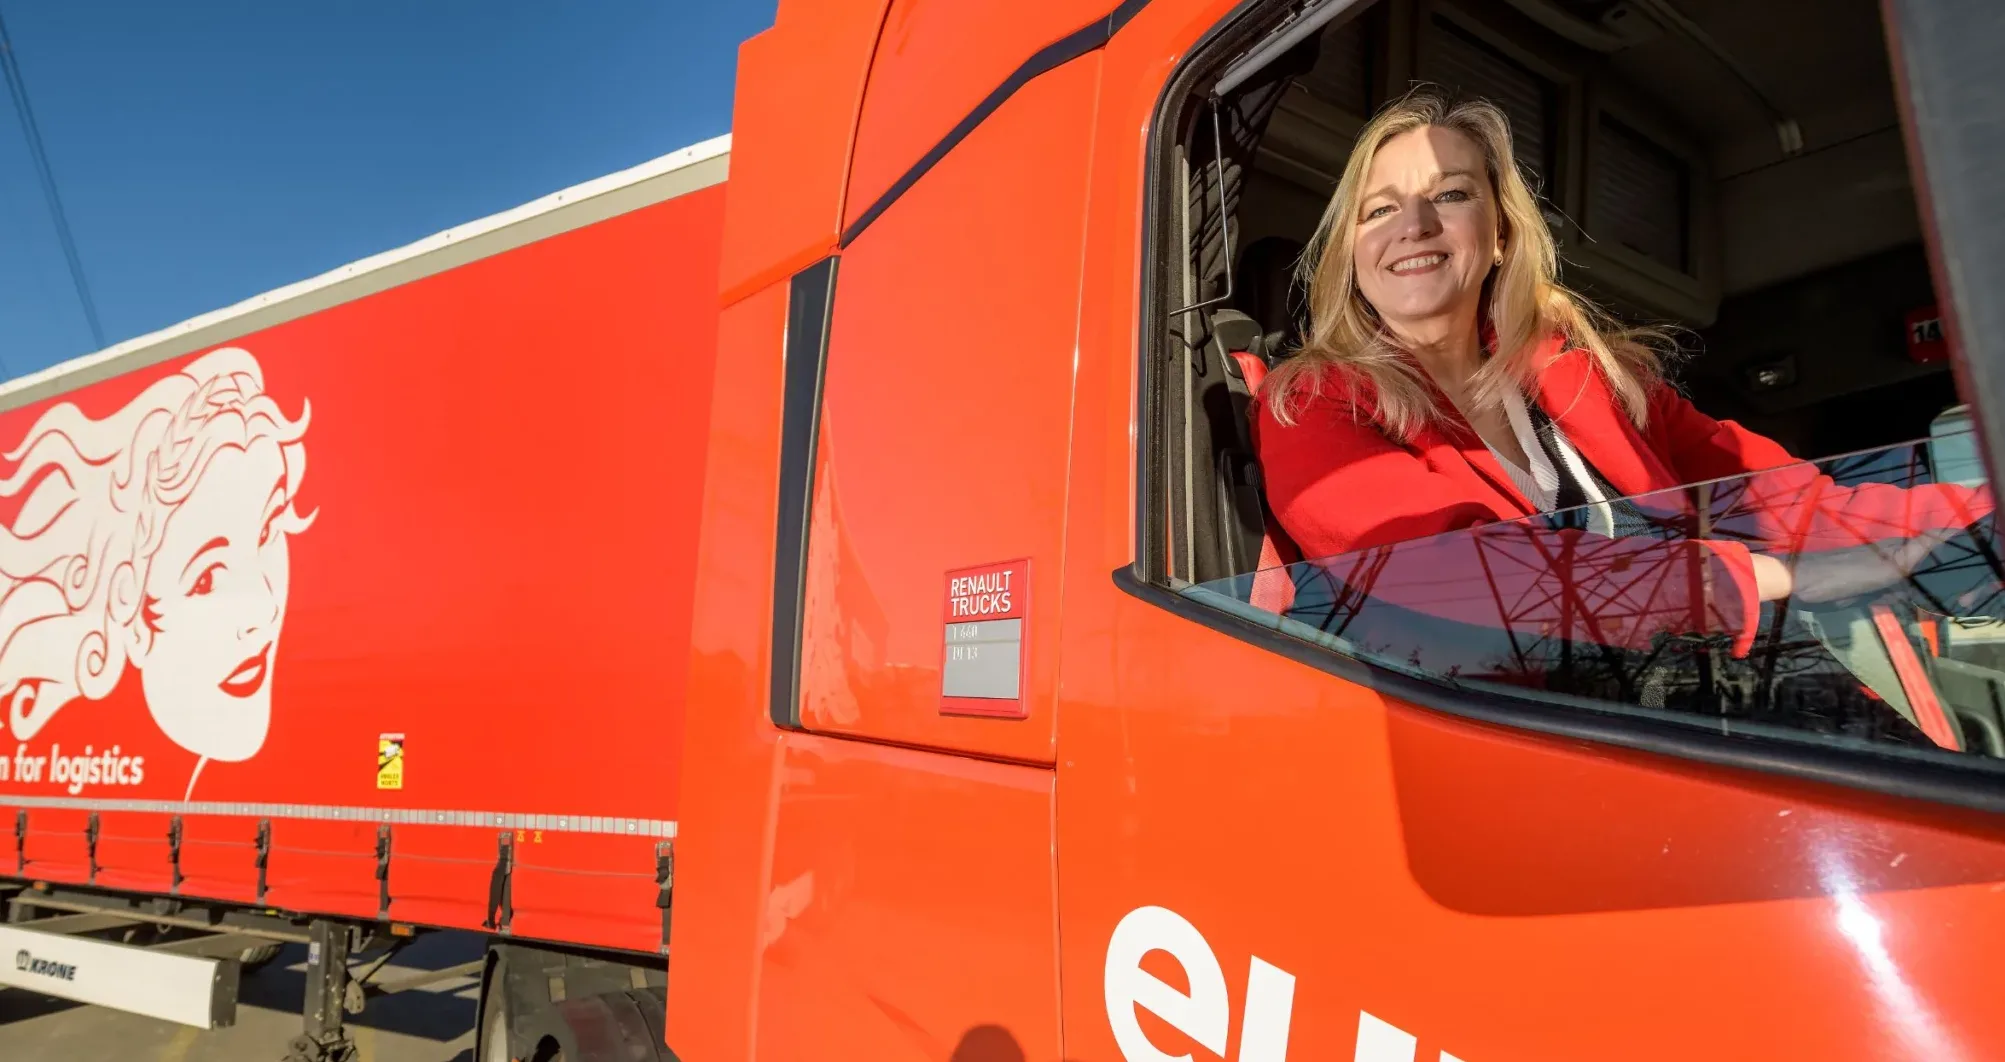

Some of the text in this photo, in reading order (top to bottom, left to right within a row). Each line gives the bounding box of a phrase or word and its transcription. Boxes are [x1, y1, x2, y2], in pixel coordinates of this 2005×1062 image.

[950, 570, 1013, 597] RENAULT
[950, 592, 1011, 617] TRUCKS
[14, 743, 47, 782] for
[49, 743, 144, 795] logistics
[30, 957, 77, 981] KRONE
[1104, 905, 1468, 1062] eu
